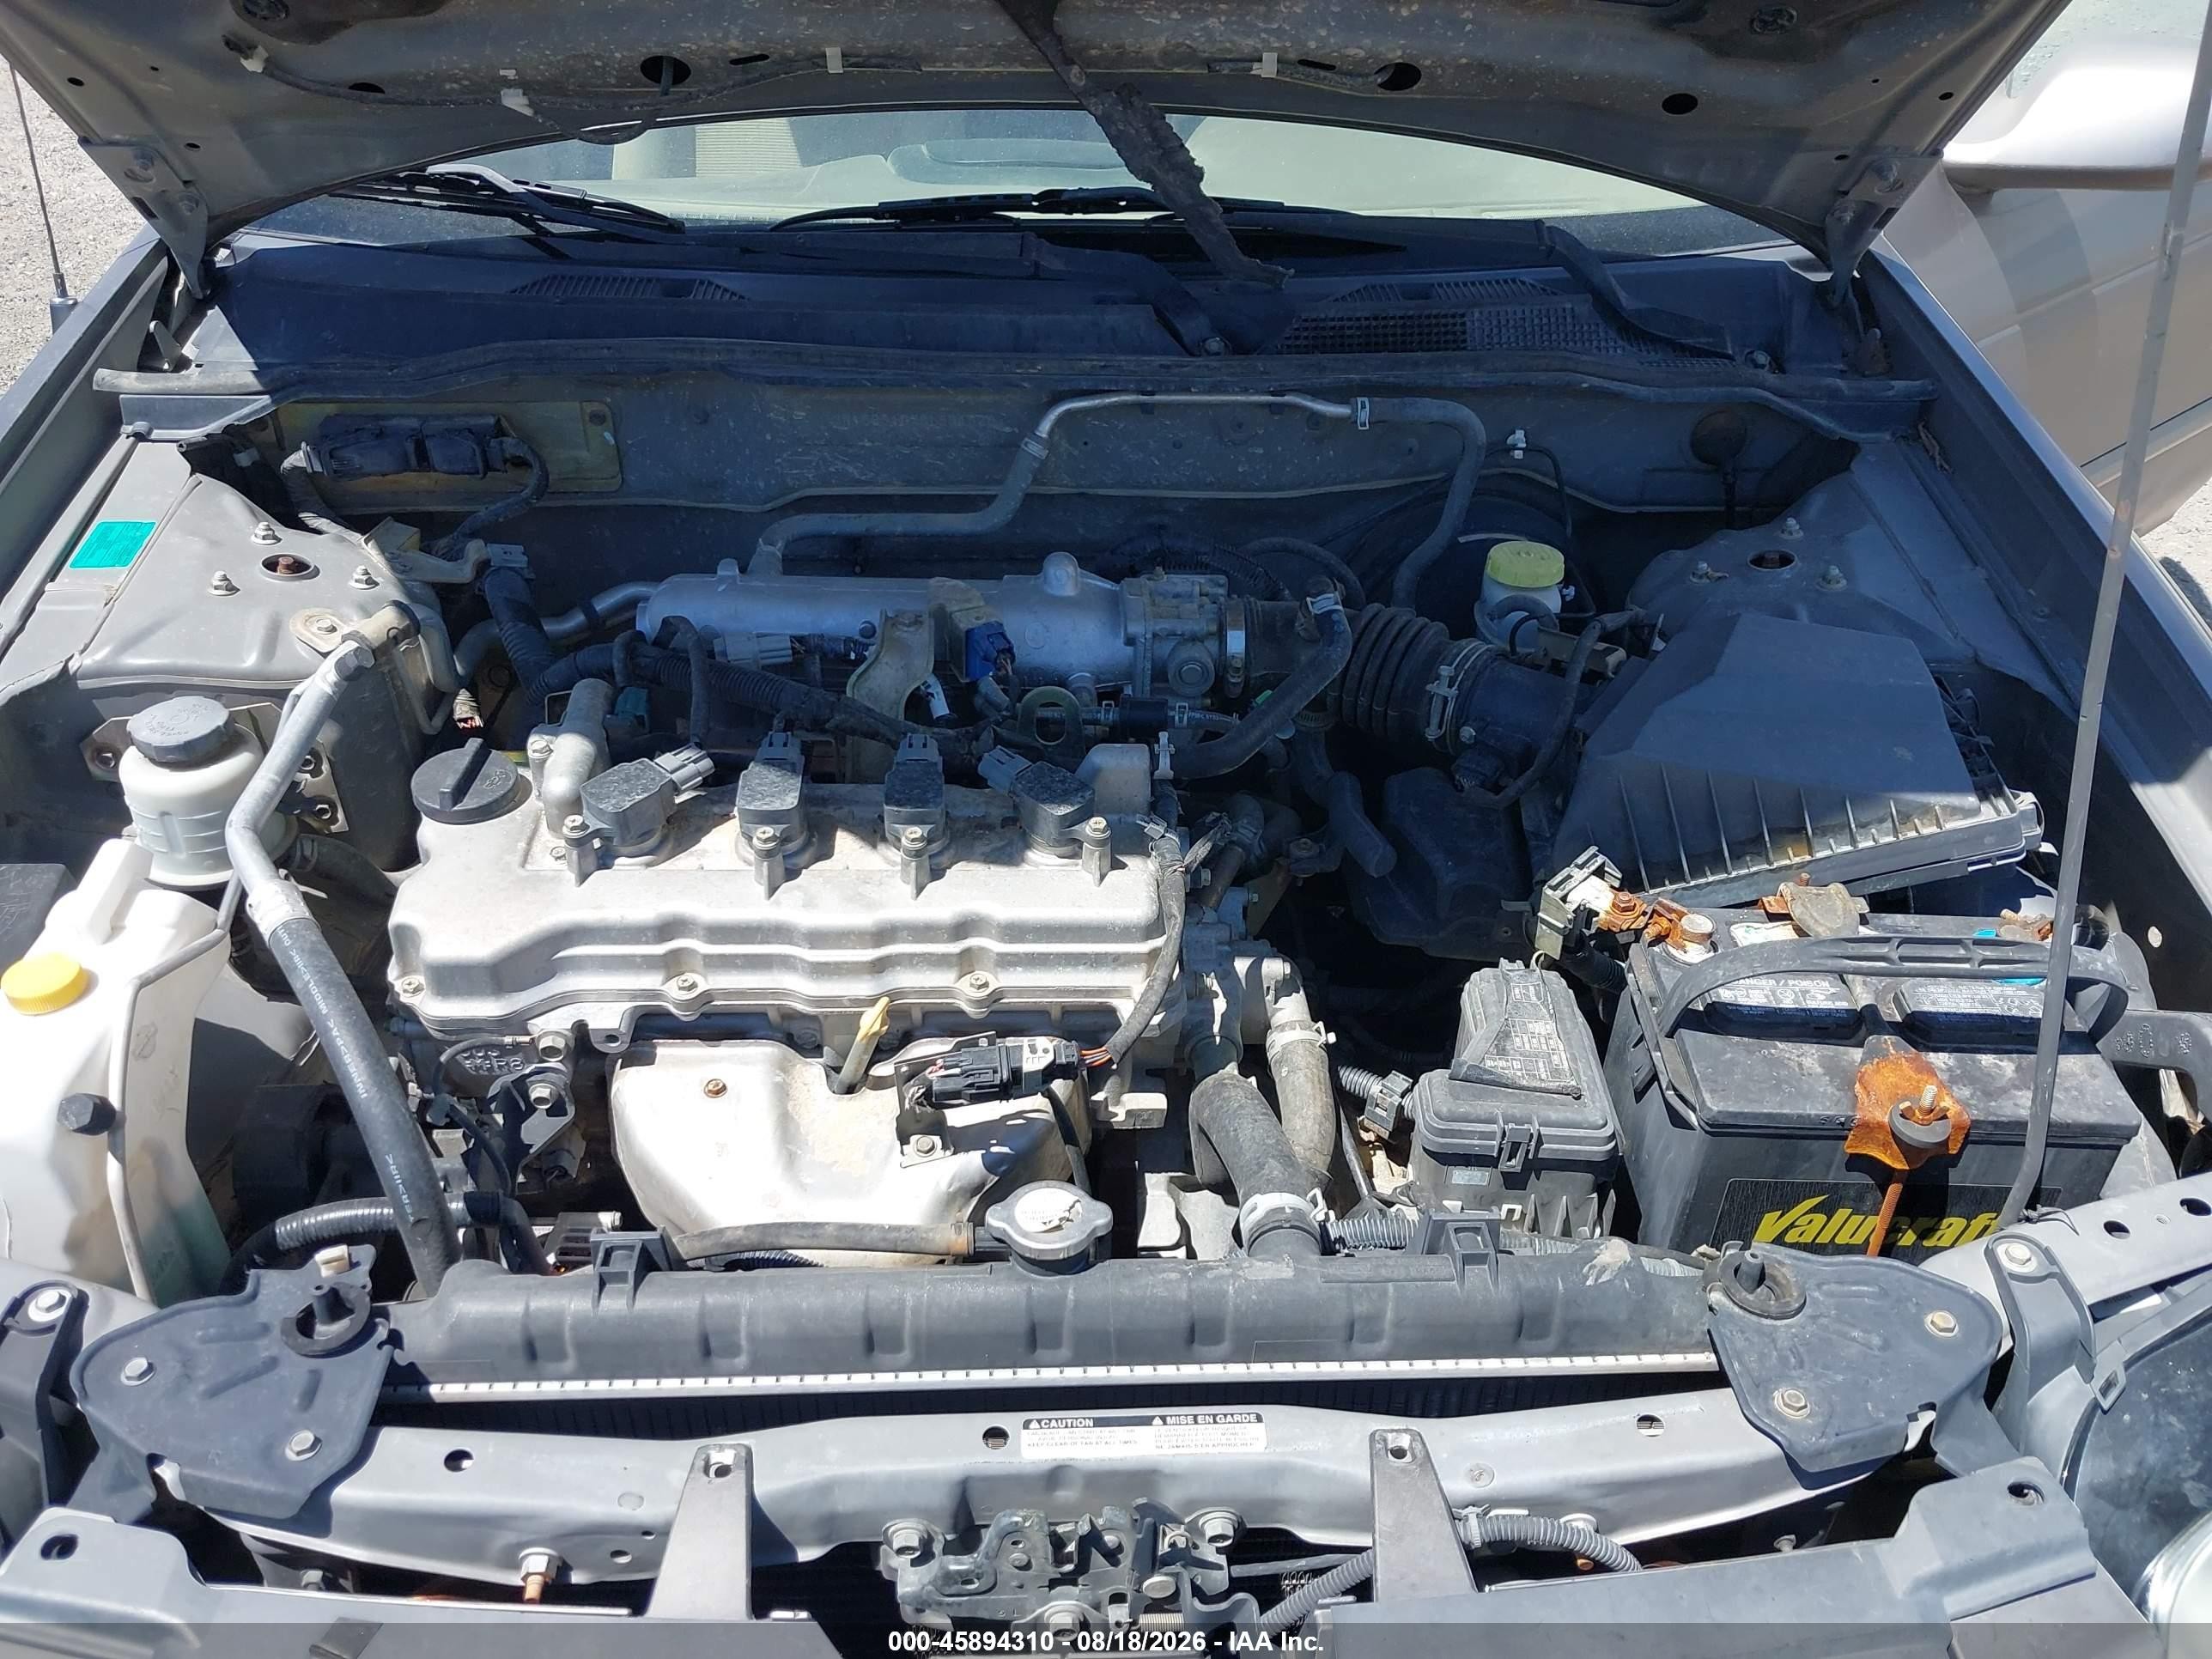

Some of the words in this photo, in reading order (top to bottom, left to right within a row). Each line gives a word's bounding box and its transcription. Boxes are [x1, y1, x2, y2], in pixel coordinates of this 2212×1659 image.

[1788, 979, 1830, 988] POISON
[1040, 1418, 1094, 1429] CAUTION
[1166, 1415, 1194, 1425] MISE
[1197, 1414, 1214, 1425] EN
[1216, 1413, 1258, 1424] GARDE
